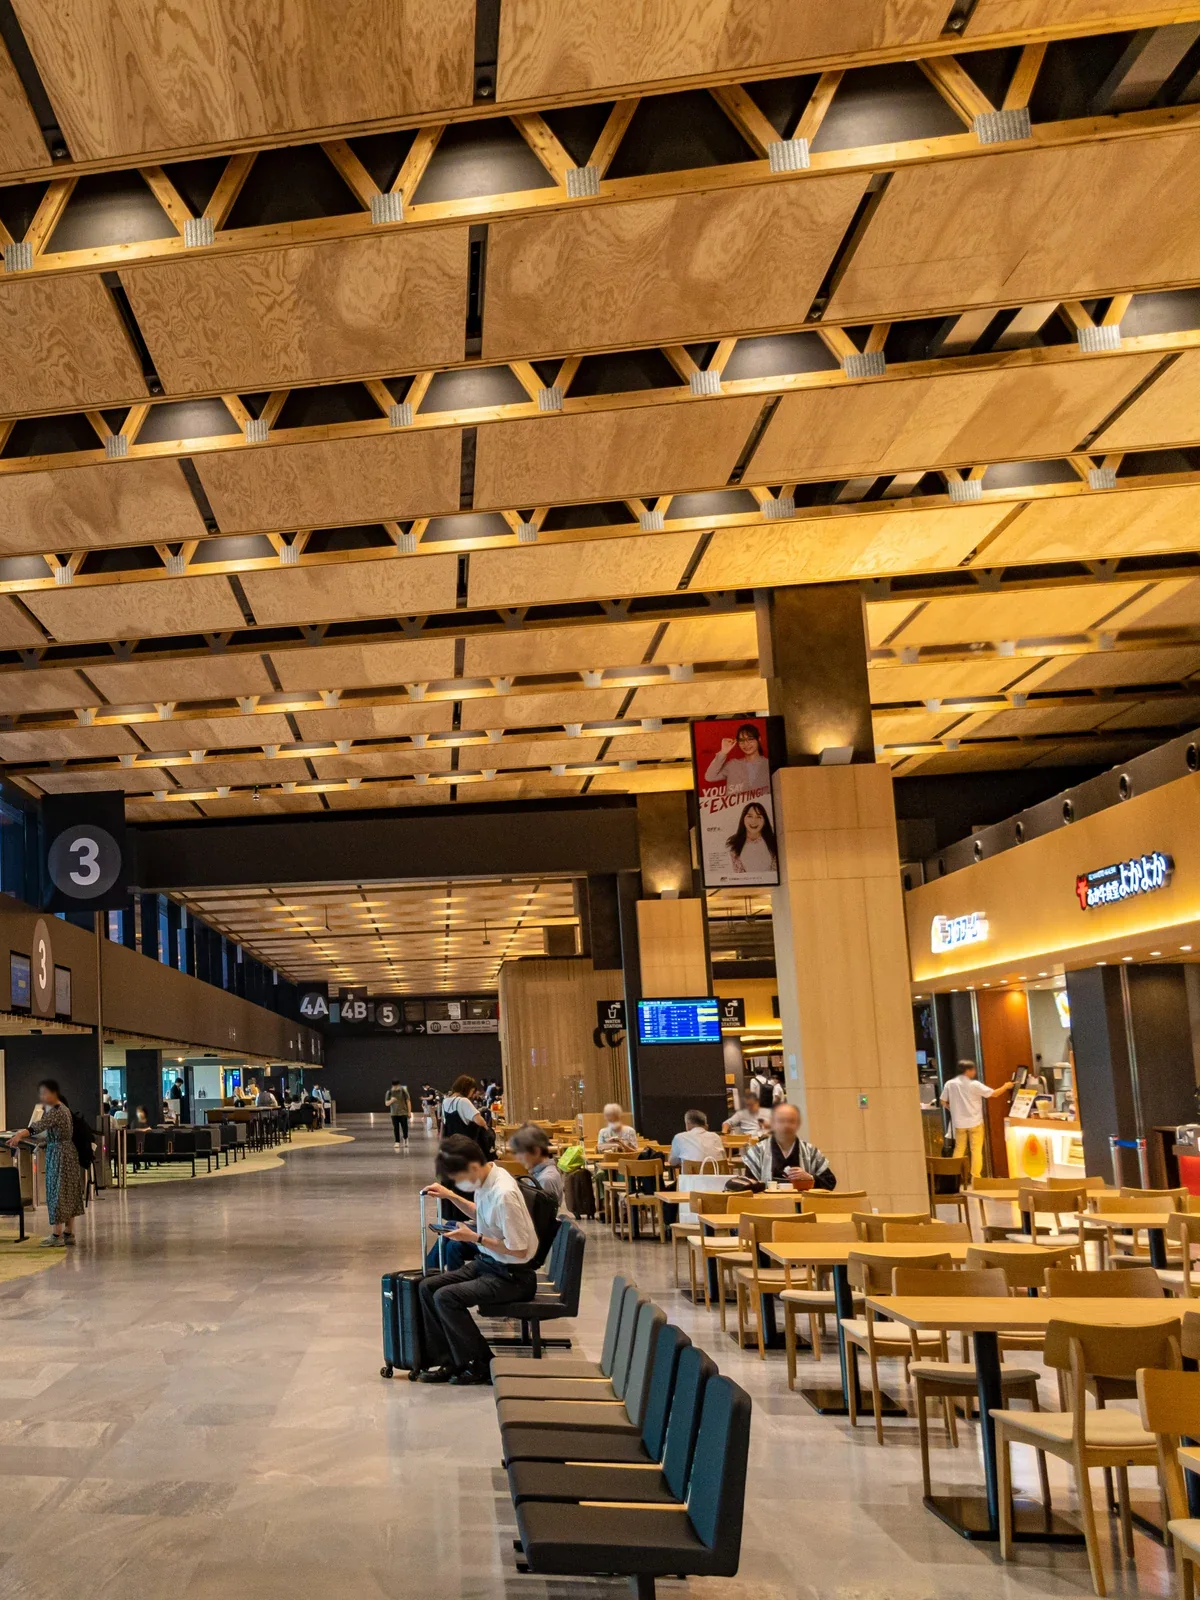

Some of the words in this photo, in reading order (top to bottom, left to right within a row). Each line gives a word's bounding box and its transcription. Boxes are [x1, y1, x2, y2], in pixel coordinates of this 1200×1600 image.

[702, 785, 727, 797] YOU
[728, 783, 744, 793] SAY
[69, 837, 101, 886] 3
[1119, 853, 1166, 897] よかよか
[38, 939, 47, 990] 3
[300, 996, 329, 1015] 4A
[341, 1002, 367, 1020] 4B
[382, 1006, 394, 1023] 5
